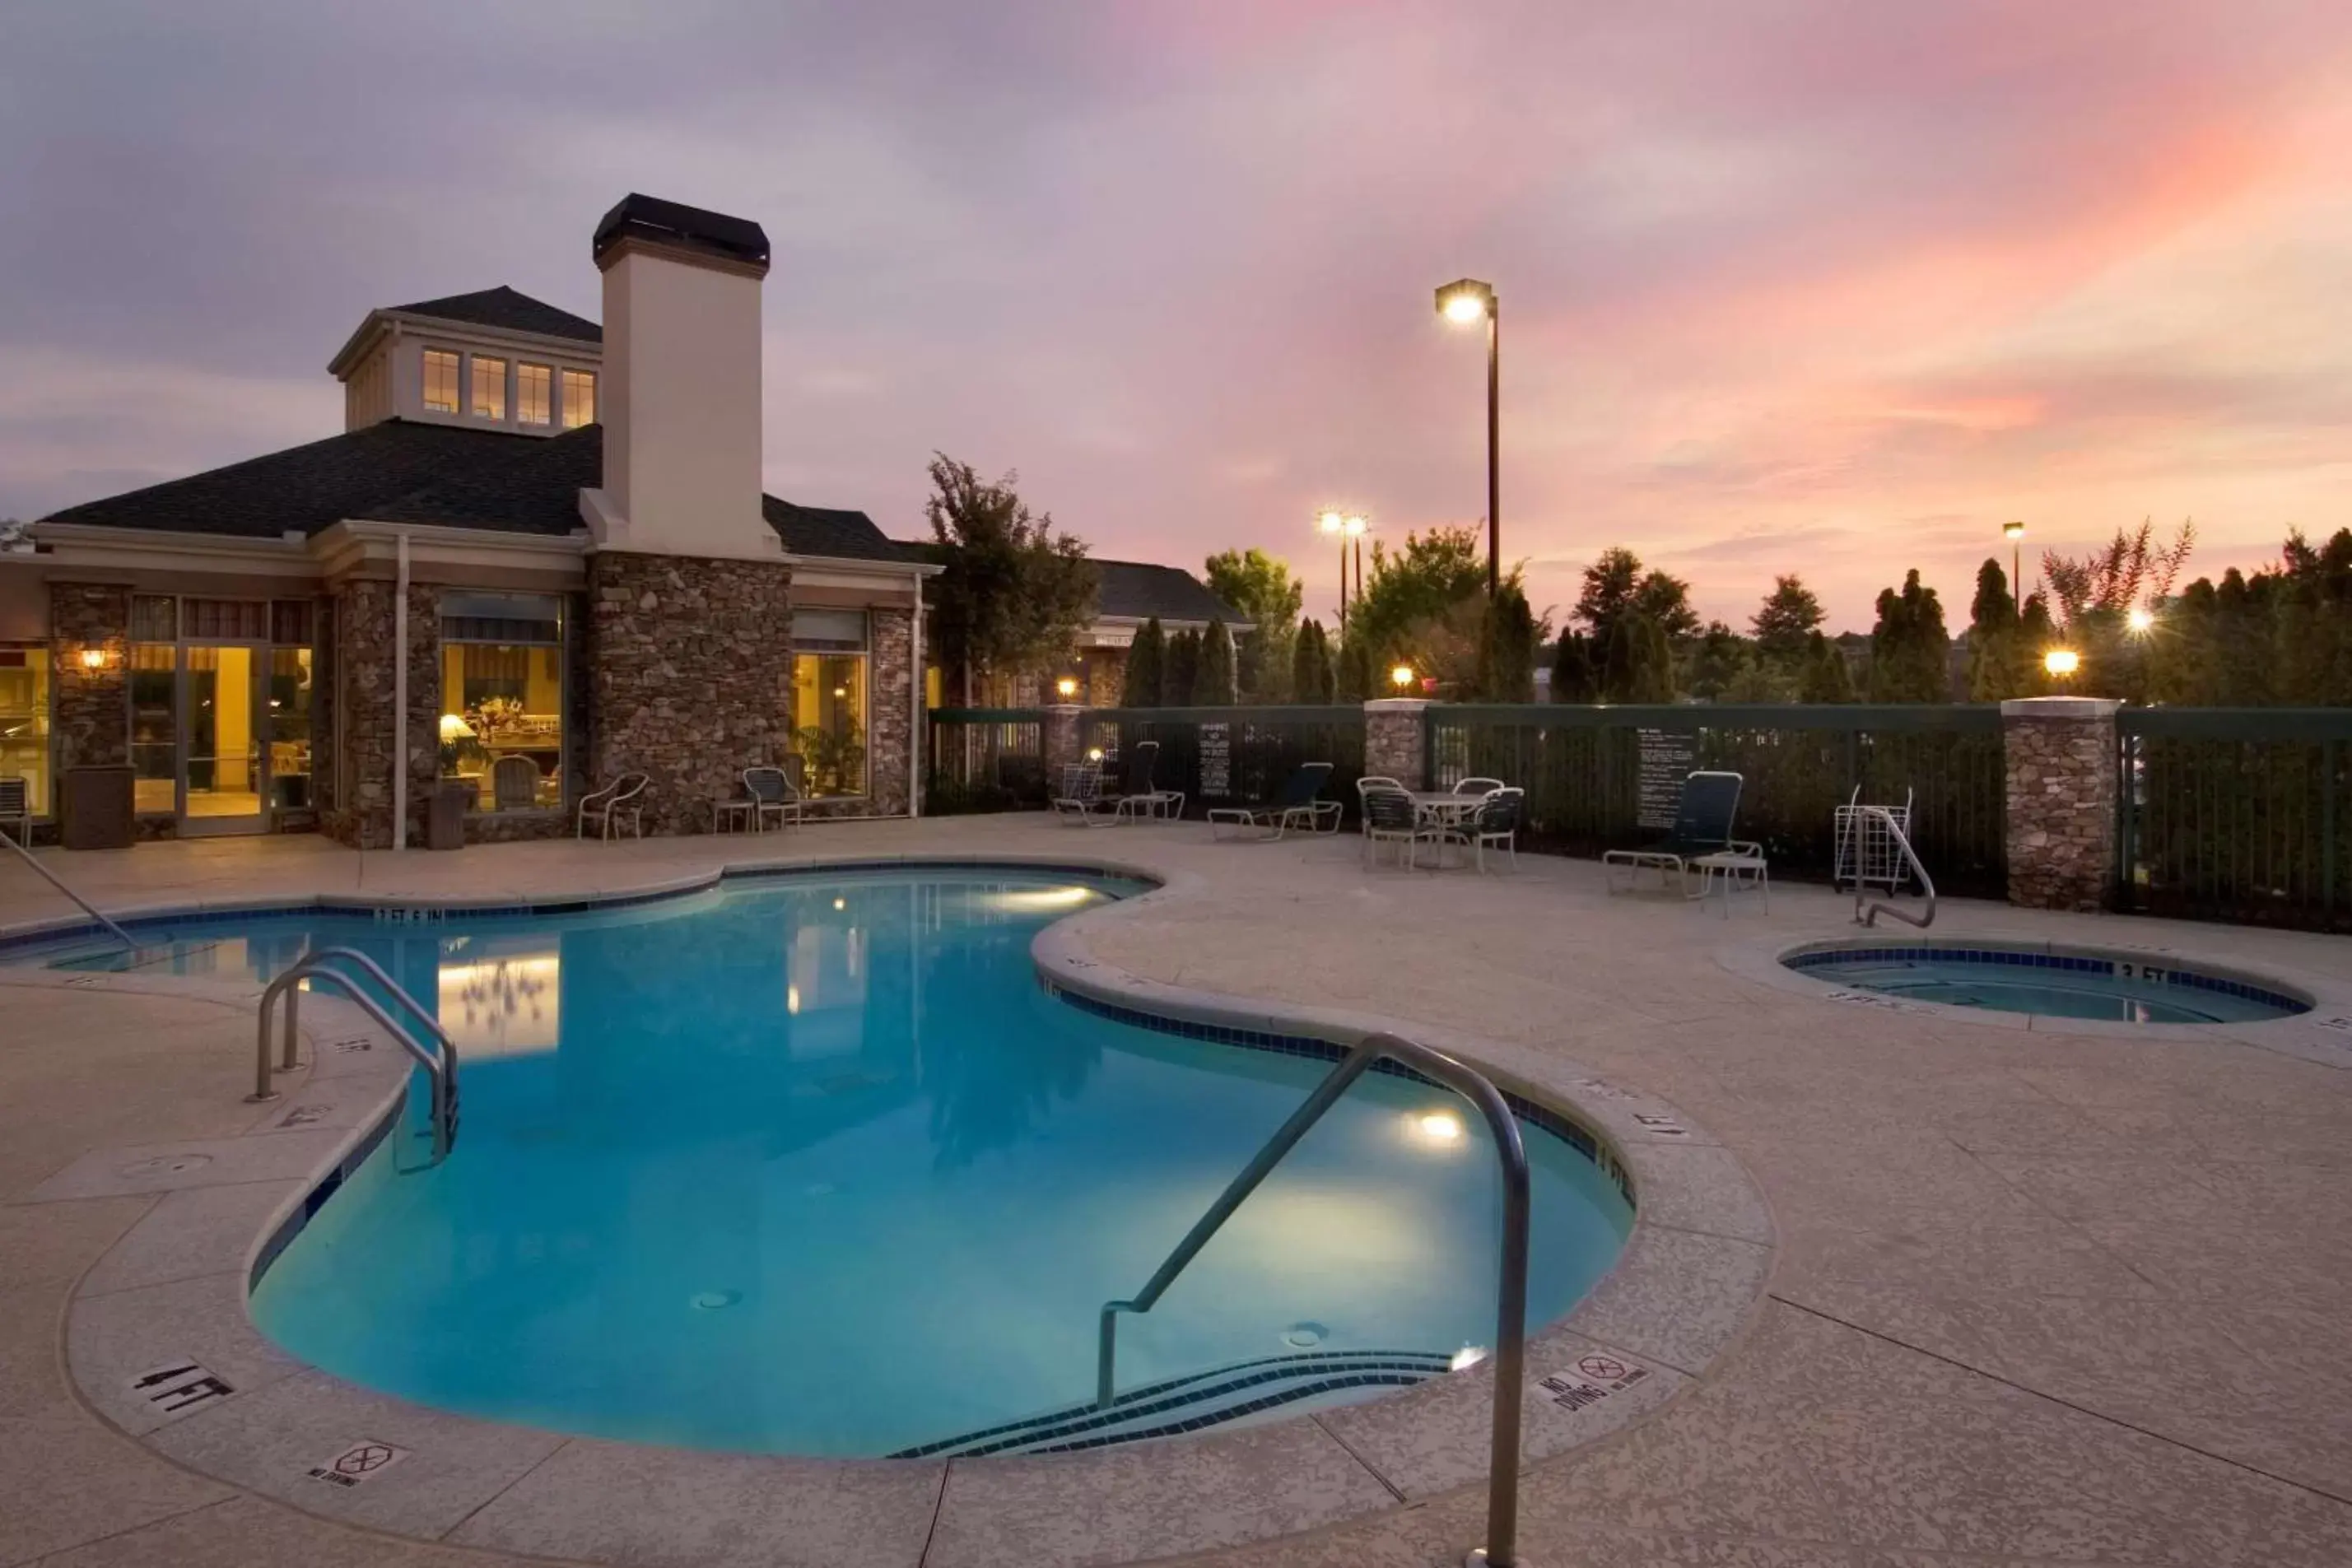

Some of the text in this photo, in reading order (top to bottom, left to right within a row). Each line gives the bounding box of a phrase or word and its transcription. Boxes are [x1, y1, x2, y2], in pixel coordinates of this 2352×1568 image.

[2143, 966, 2165, 981] FT
[133, 1365, 234, 1412] 4 FT
[1539, 1377, 1572, 1395] NO
[1552, 1384, 1609, 1412] DIVING
